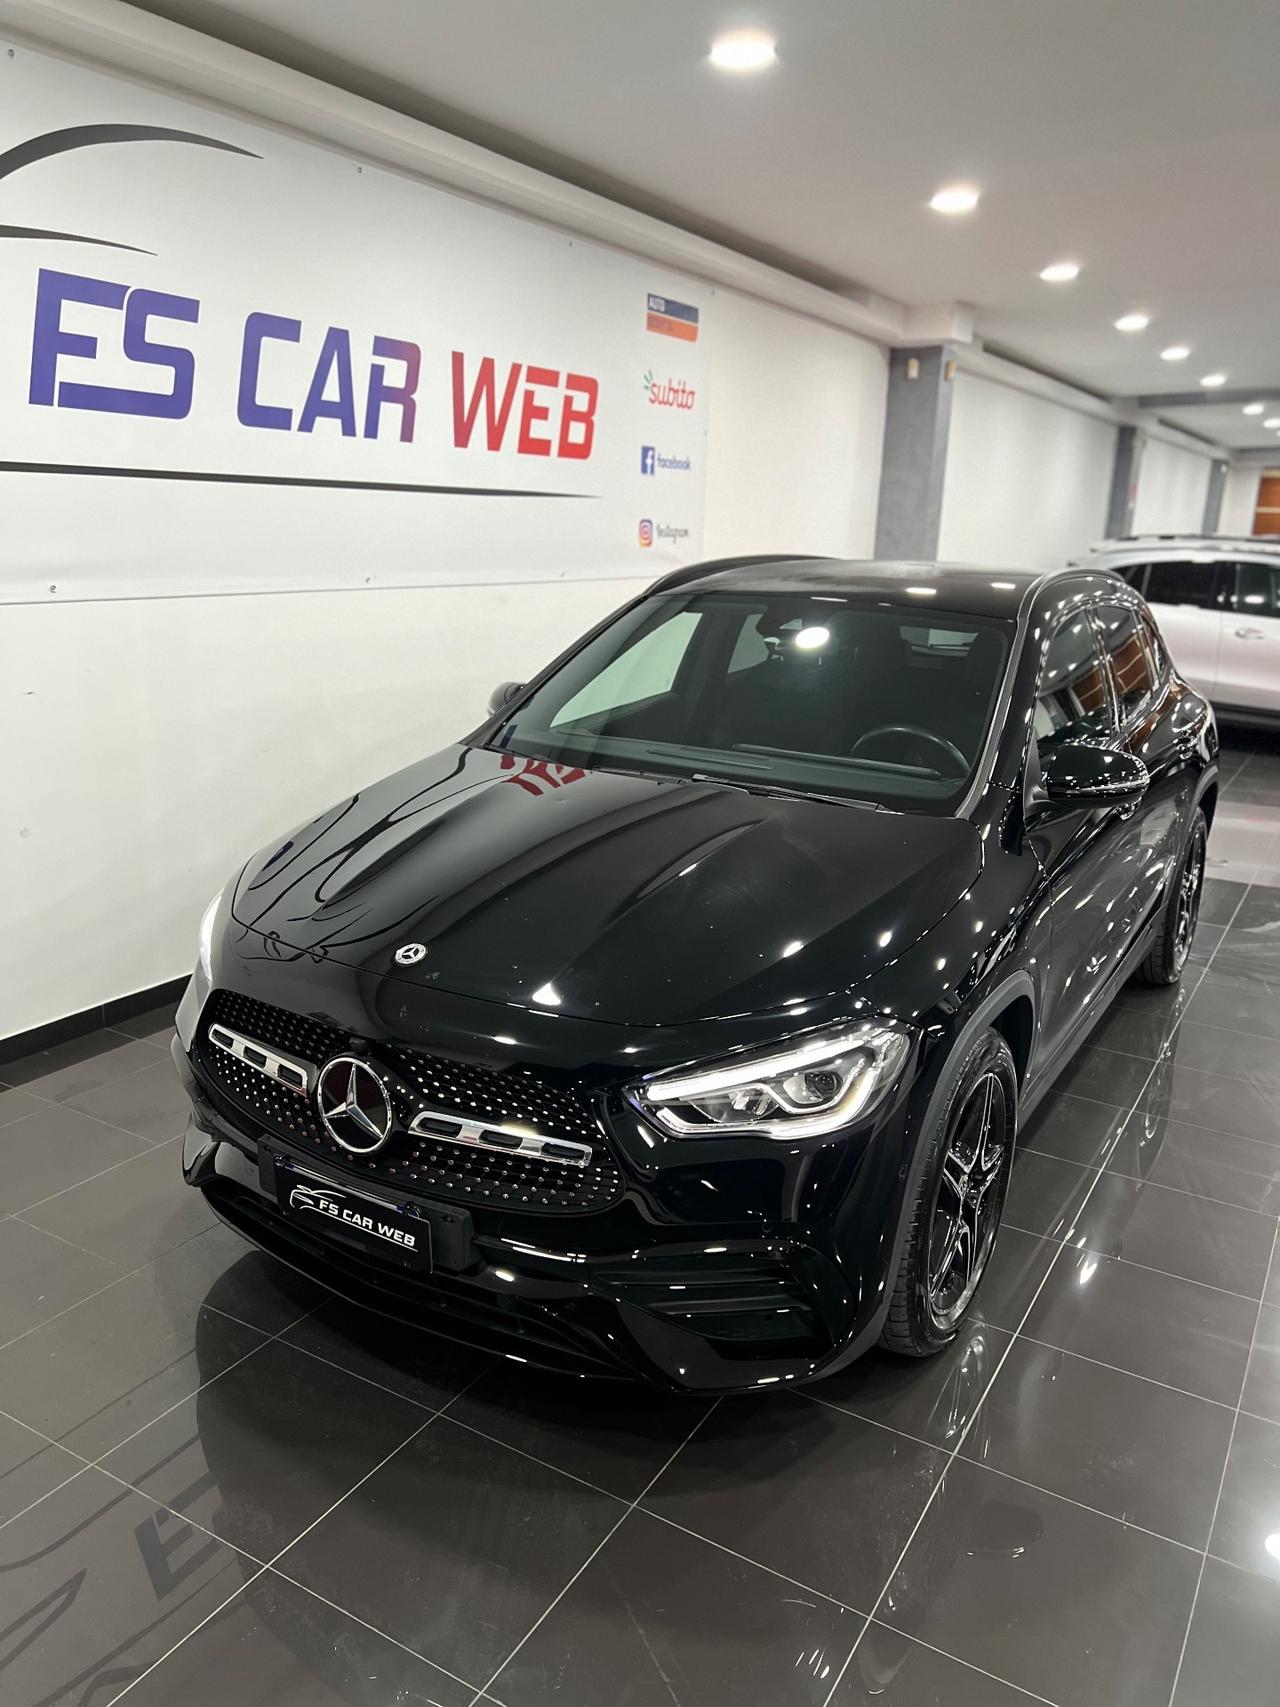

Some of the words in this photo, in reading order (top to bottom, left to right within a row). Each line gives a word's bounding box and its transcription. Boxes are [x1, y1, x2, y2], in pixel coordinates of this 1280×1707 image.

[29, 267, 200, 420] FS
[237, 311, 422, 444] CAR
[451, 350, 599, 460] WEB
[648, 376, 695, 410] subito
[657, 452, 691, 470] facebook
[319, 1199, 340, 1215] FS
[342, 1209, 374, 1230] CAR
[377, 1222, 416, 1247] WEB
